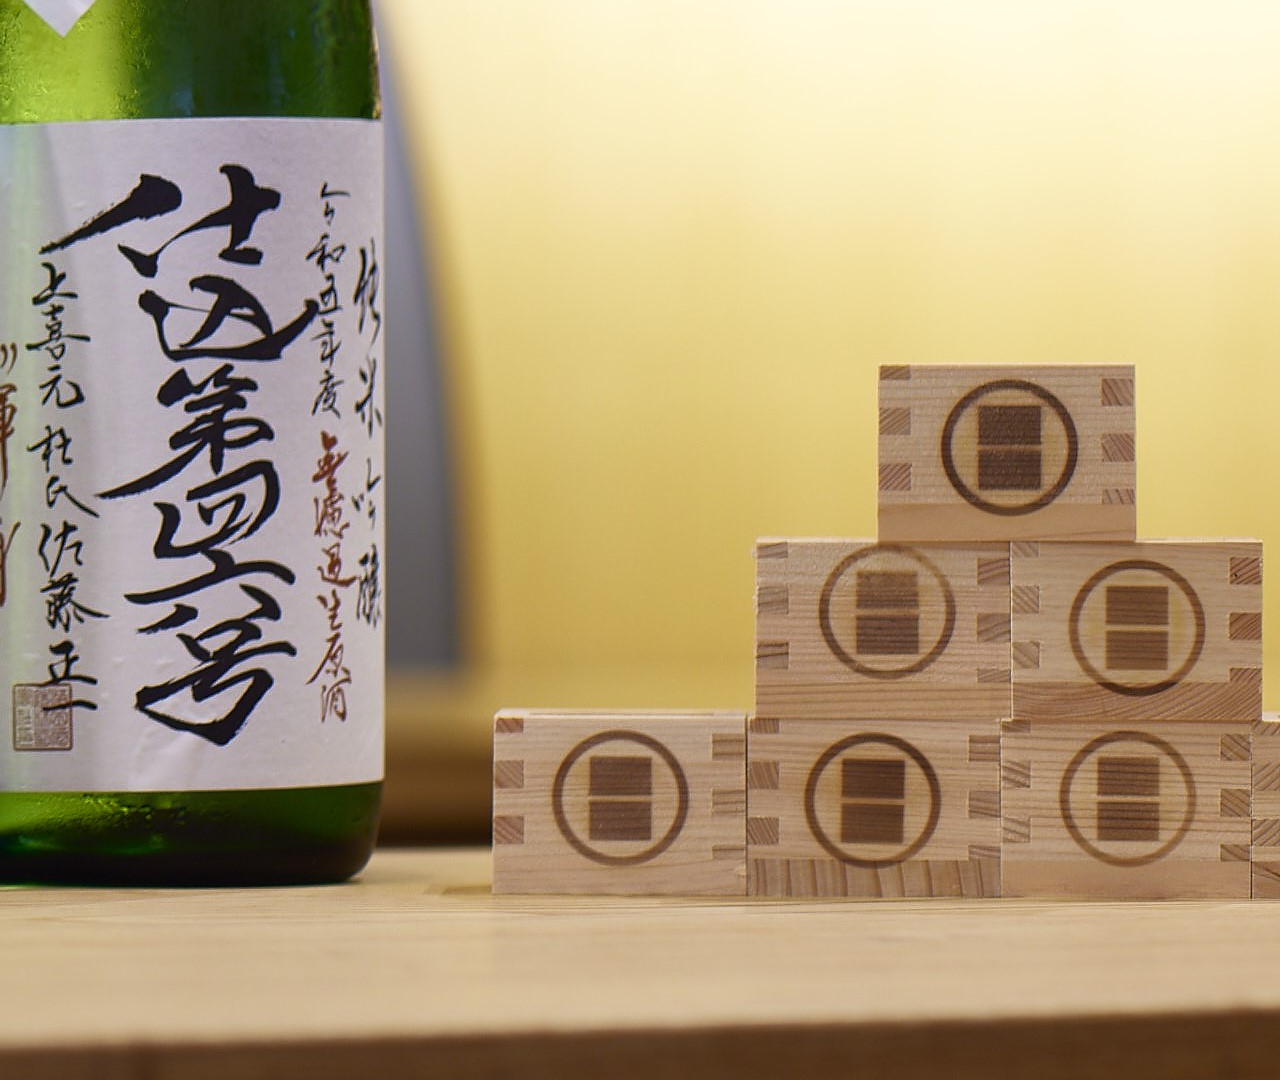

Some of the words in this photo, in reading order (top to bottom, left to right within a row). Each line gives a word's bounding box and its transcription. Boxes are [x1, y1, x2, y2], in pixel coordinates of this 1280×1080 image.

[305, 181, 351, 420] 令和五年度
